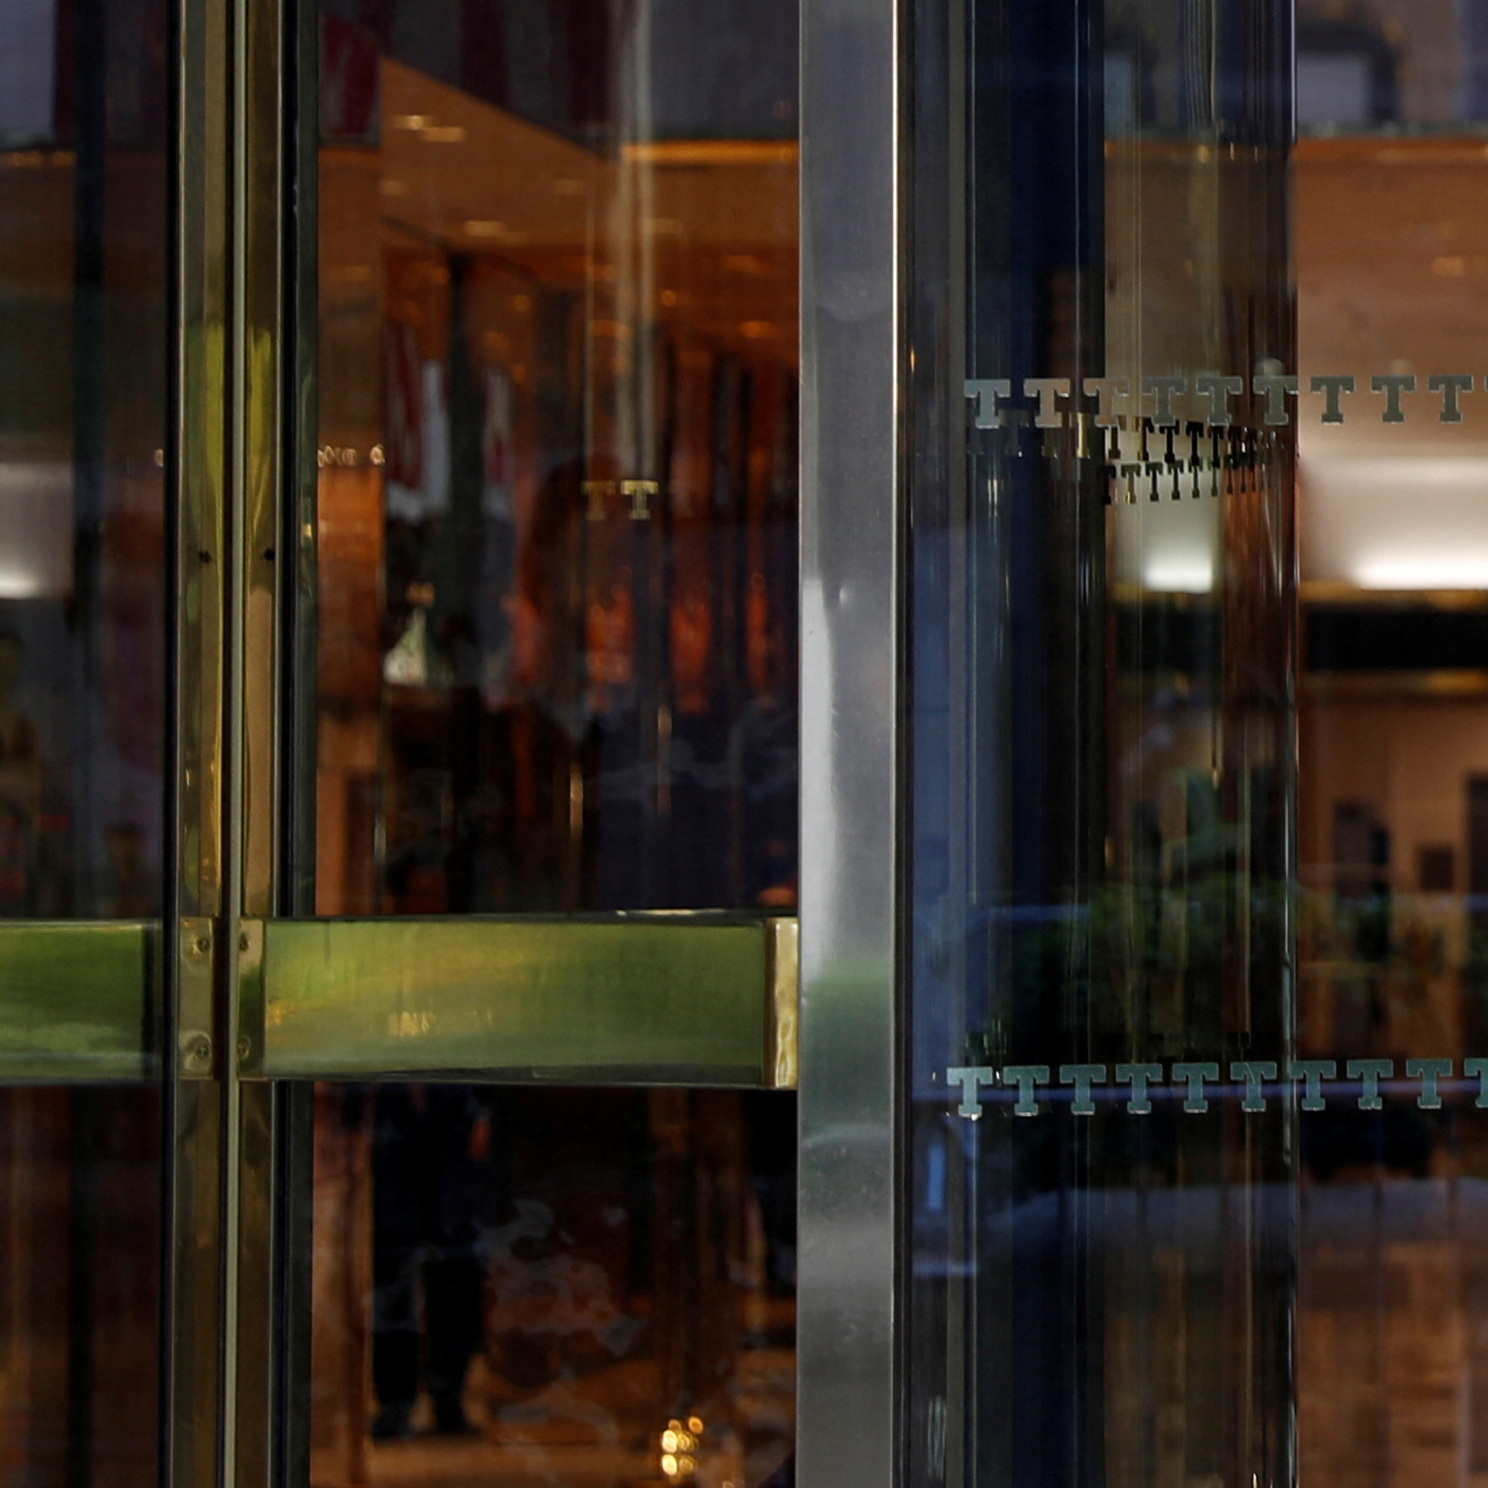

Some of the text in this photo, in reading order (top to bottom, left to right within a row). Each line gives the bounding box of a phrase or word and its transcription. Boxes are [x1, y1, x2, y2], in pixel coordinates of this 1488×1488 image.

[964, 377, 1010, 428] T
[1024, 377, 1070, 427] T
[1083, 376, 1130, 426] T
[1142, 376, 1188, 426] T
[1196, 375, 1242, 425] T
[1253, 375, 1300, 424] T
[1310, 374, 1356, 423] T
[1370, 374, 1417, 423] T
[1428, 373, 1474, 422] T
[946, 1066, 993, 1117] T
[1003, 1065, 1050, 1116] T
[1060, 1064, 1106, 1115] T
[1115, 1063, 1162, 1114] T
[1172, 1062, 1219, 1113] T
[1230, 1061, 1278, 1112] T
[1290, 1060, 1336, 1111] T
[1347, 1059, 1394, 1110] T
[1406, 1059, 1452, 1109] T
